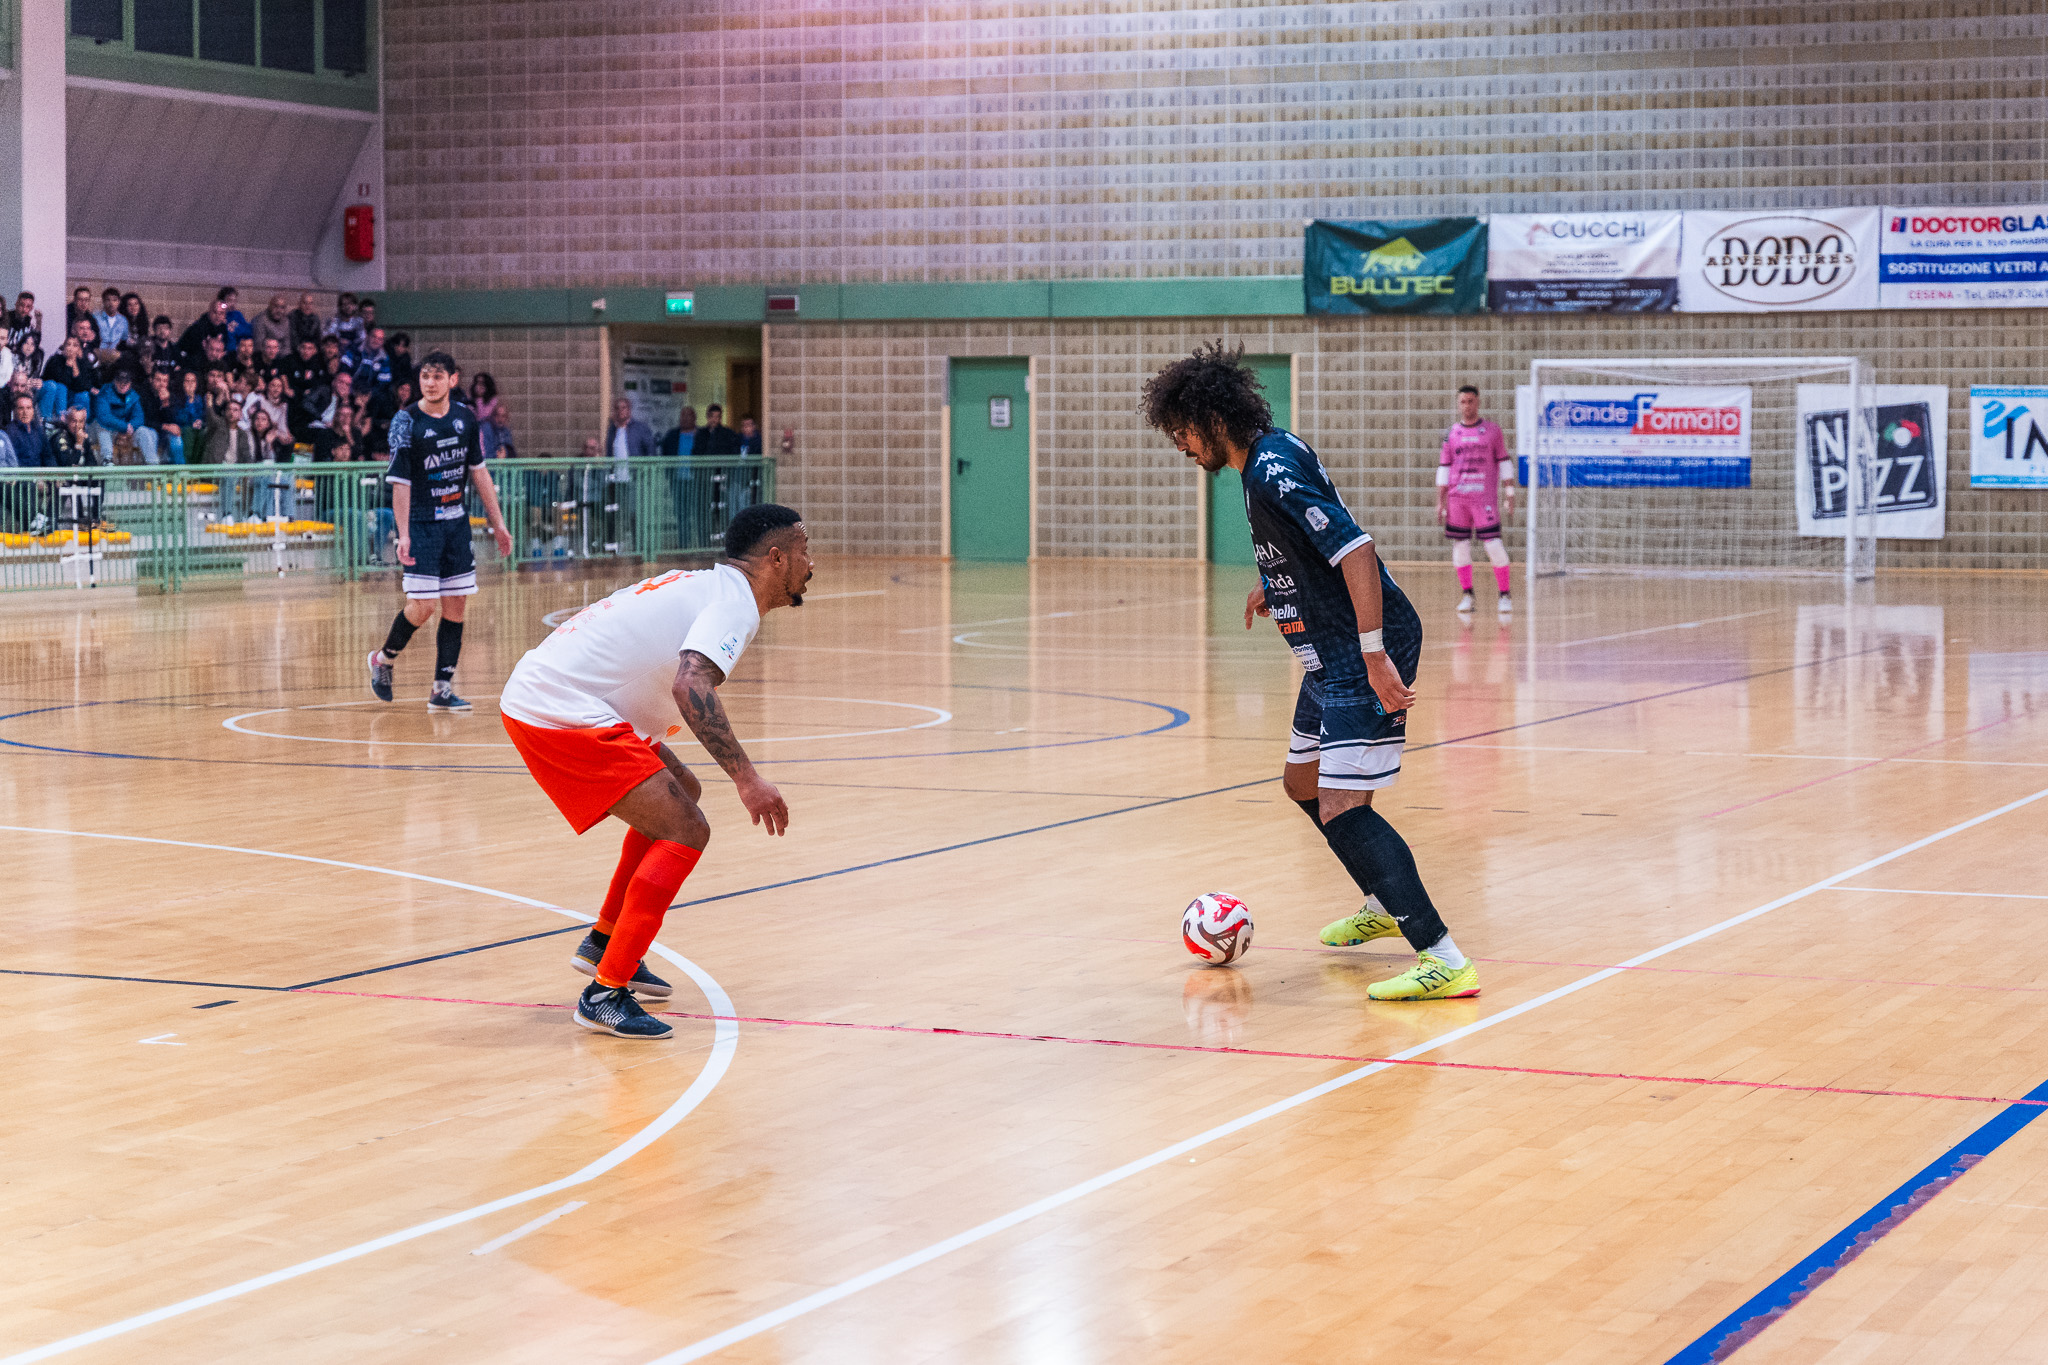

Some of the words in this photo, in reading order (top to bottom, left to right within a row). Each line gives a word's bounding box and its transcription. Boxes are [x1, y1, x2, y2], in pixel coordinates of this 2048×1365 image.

[1551, 220, 1646, 239] CUCCHI
[1911, 214, 2048, 233] DOCTORGLA
[1705, 253, 1855, 266] ADVENTURES
[1720, 234, 1844, 286] DODO
[1888, 262, 1991, 275] SOSTITUZIONE
[1994, 261, 2037, 273] VETRI
[1330, 275, 1455, 295] BULLTEC
[1908, 289, 1954, 300] CESENA
